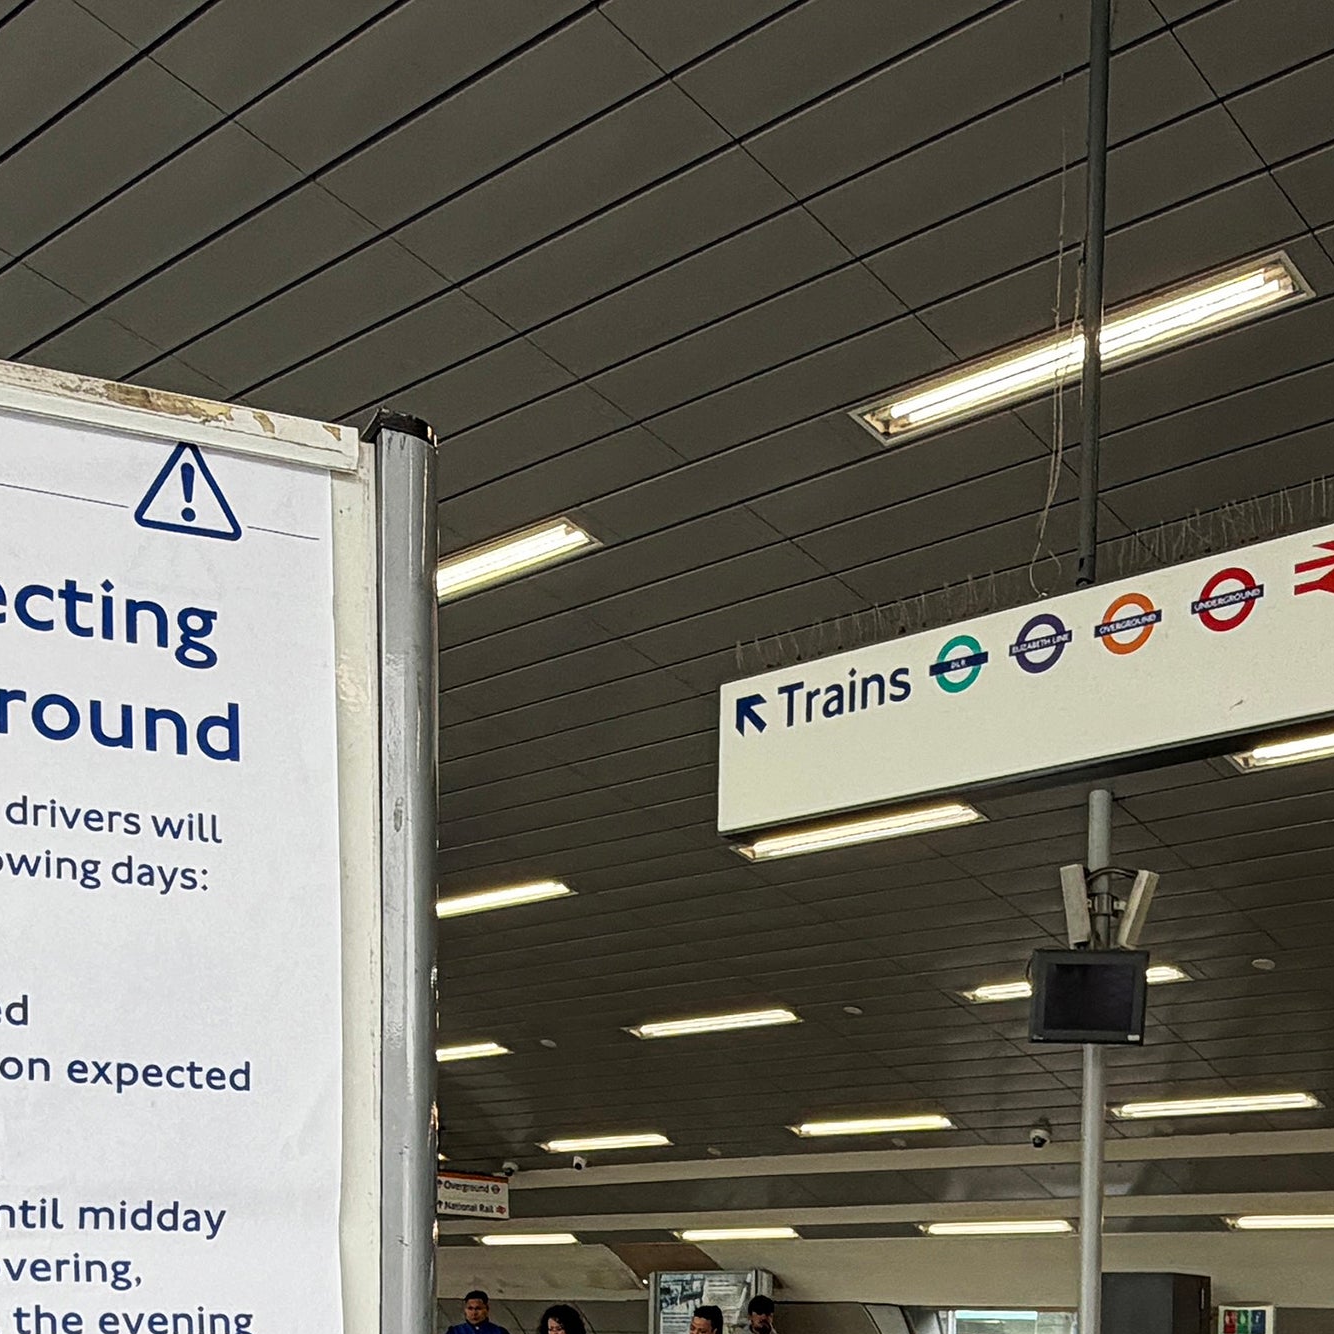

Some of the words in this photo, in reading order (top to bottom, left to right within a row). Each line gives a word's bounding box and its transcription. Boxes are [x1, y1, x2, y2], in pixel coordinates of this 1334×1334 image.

[1194, 588, 1260, 612] UNDERGROUND
[1099, 613, 1157, 634] OVERGROUND
[777, 665, 911, 728] Trains
[6, 795, 141, 835] drivers
[151, 813, 222, 843] will
[67, 1060, 250, 1093] expected
[79, 1200, 226, 1240] midday
